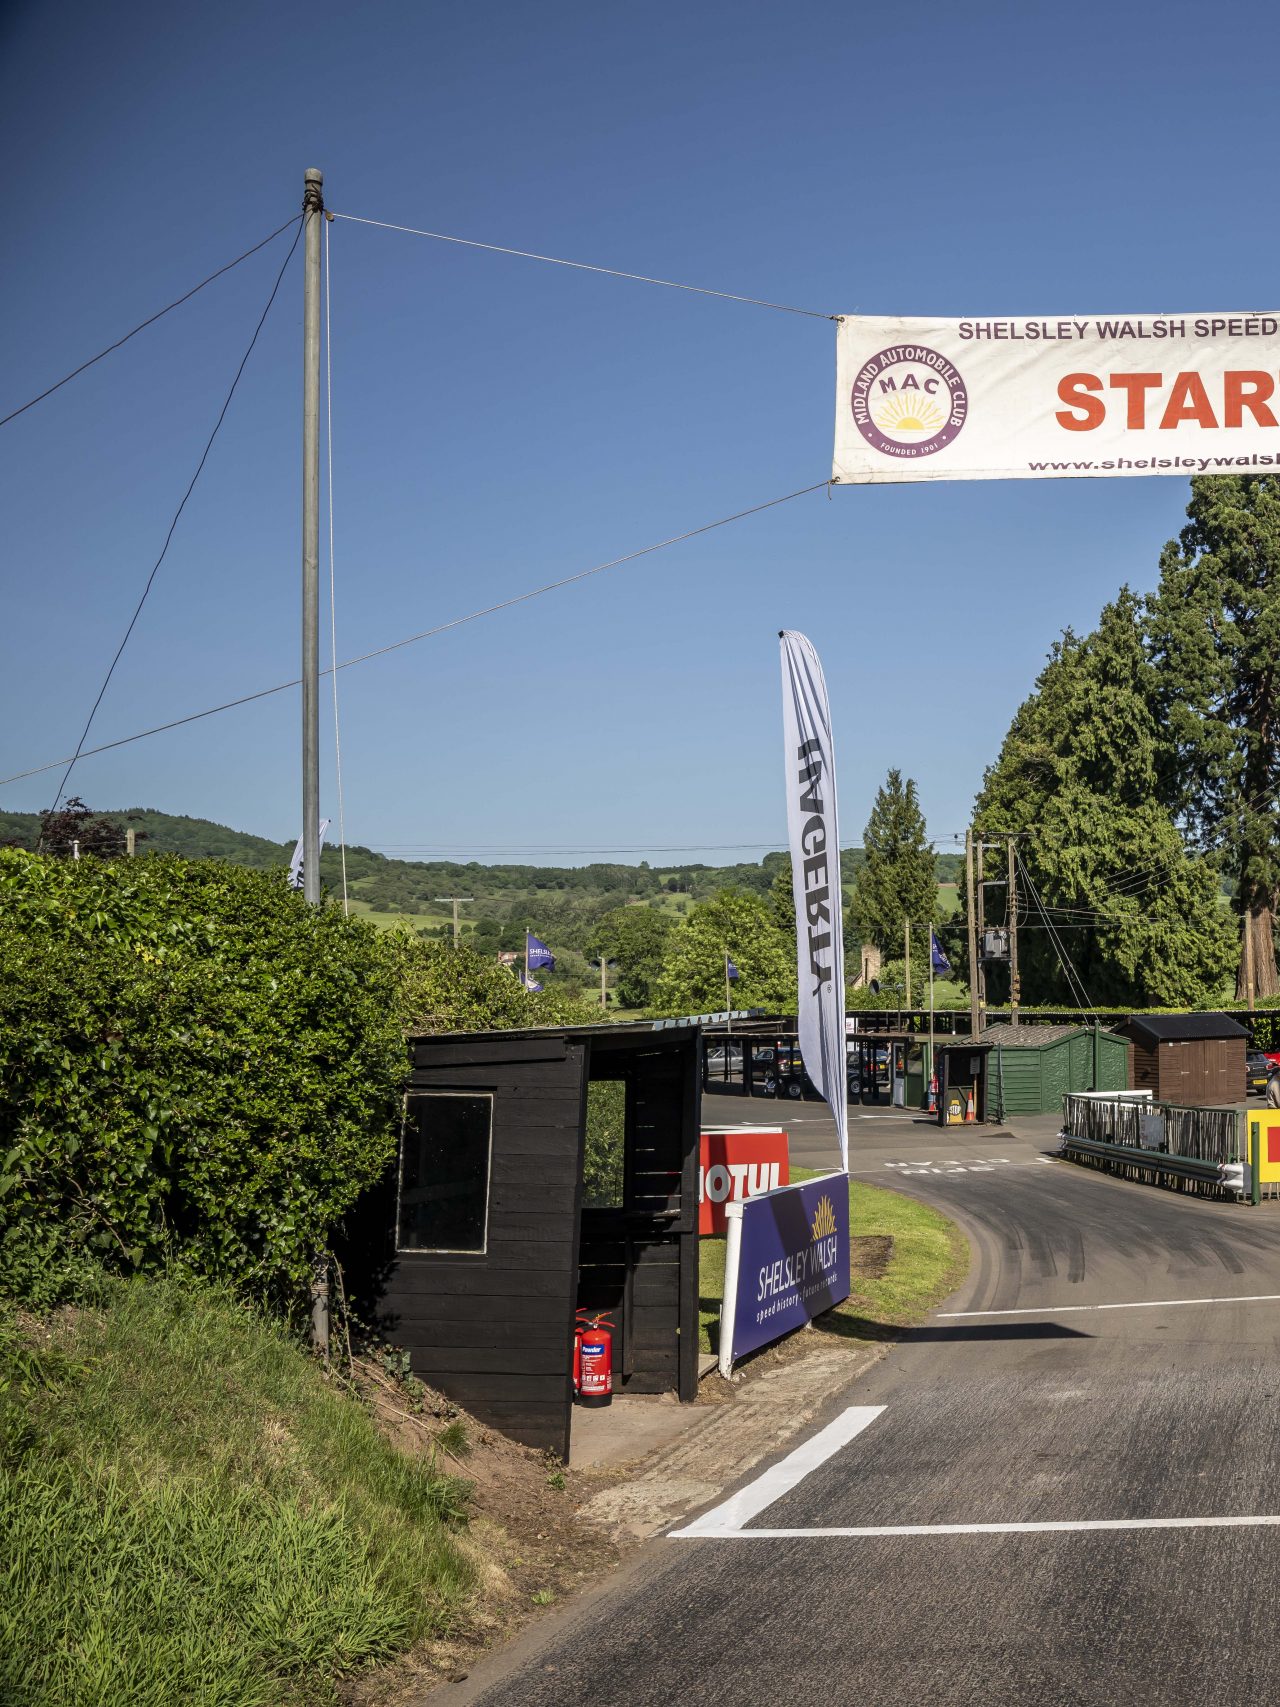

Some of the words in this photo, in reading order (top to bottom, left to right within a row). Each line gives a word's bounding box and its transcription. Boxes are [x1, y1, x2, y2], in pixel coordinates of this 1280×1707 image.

[958, 321, 1091, 341] SHELSLEY
[1096, 319, 1186, 339] WALSH
[1194, 317, 1278, 337] SPEED
[854, 363, 879, 425] MIDLAND
[879, 347, 960, 388] AUTOMOBILE
[949, 391, 965, 427] CLUB
[879, 373, 940, 395] MAC
[880, 442, 917, 456] FOUNDED
[921, 442, 939, 454] 1901
[699, 1162, 780, 1203] OTUL
[757, 1248, 808, 1302] SHELSLEY
[809, 1235, 838, 1273] WALSH
[756, 1301, 776, 1325] speed
